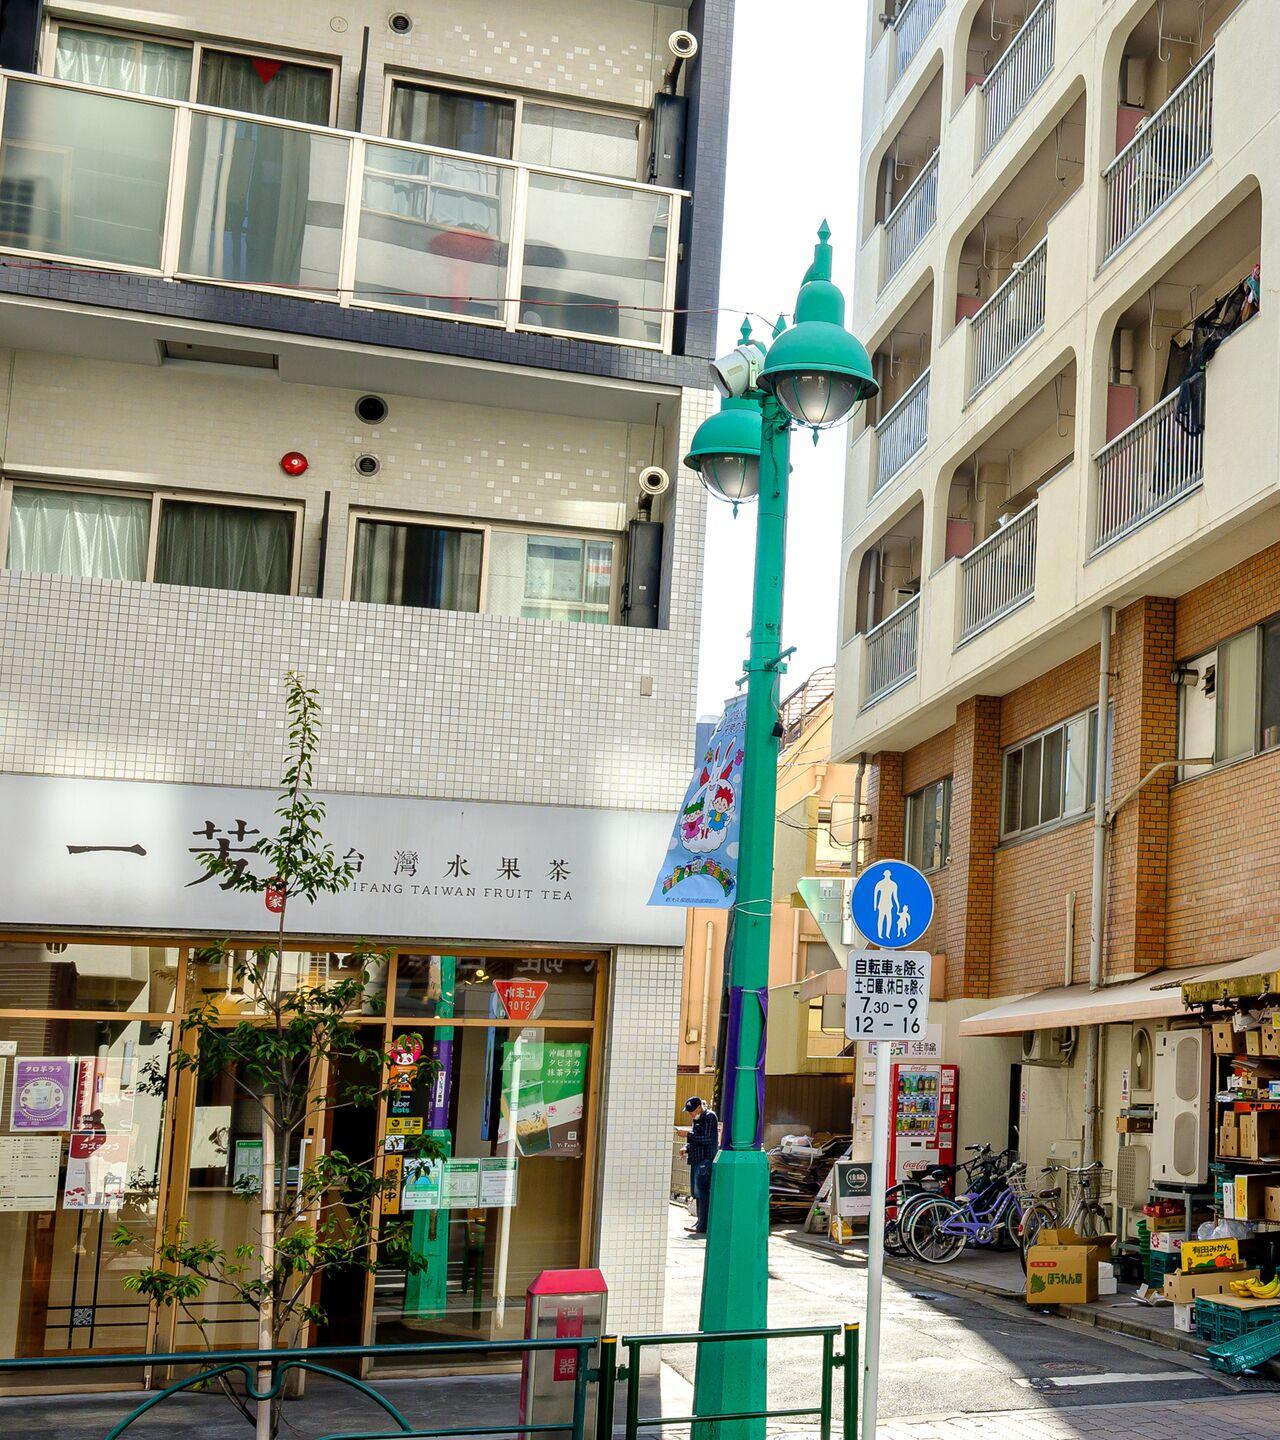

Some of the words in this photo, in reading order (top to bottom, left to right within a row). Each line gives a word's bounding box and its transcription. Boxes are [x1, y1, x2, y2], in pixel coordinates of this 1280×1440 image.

[342, 882, 403, 894] IFANG
[411, 885, 476, 897] TAIWAN
[484, 888, 533, 899] FRUIT
[541, 890, 573, 901] TEA
[855, 958, 925, 976] 自転車を除く
[855, 978, 924, 995] 土・日曜、休日を除く
[860, 997, 889, 1013] 7.30
[908, 998, 918, 1014] 9
[855, 1016, 874, 1033] 12
[903, 1017, 920, 1034] 16
[902, 1160, 929, 1171] Coca-Col
[1192, 1244, 1231, 1254] 有田みかん
[1047, 1272, 1083, 1285] ほうれん草
